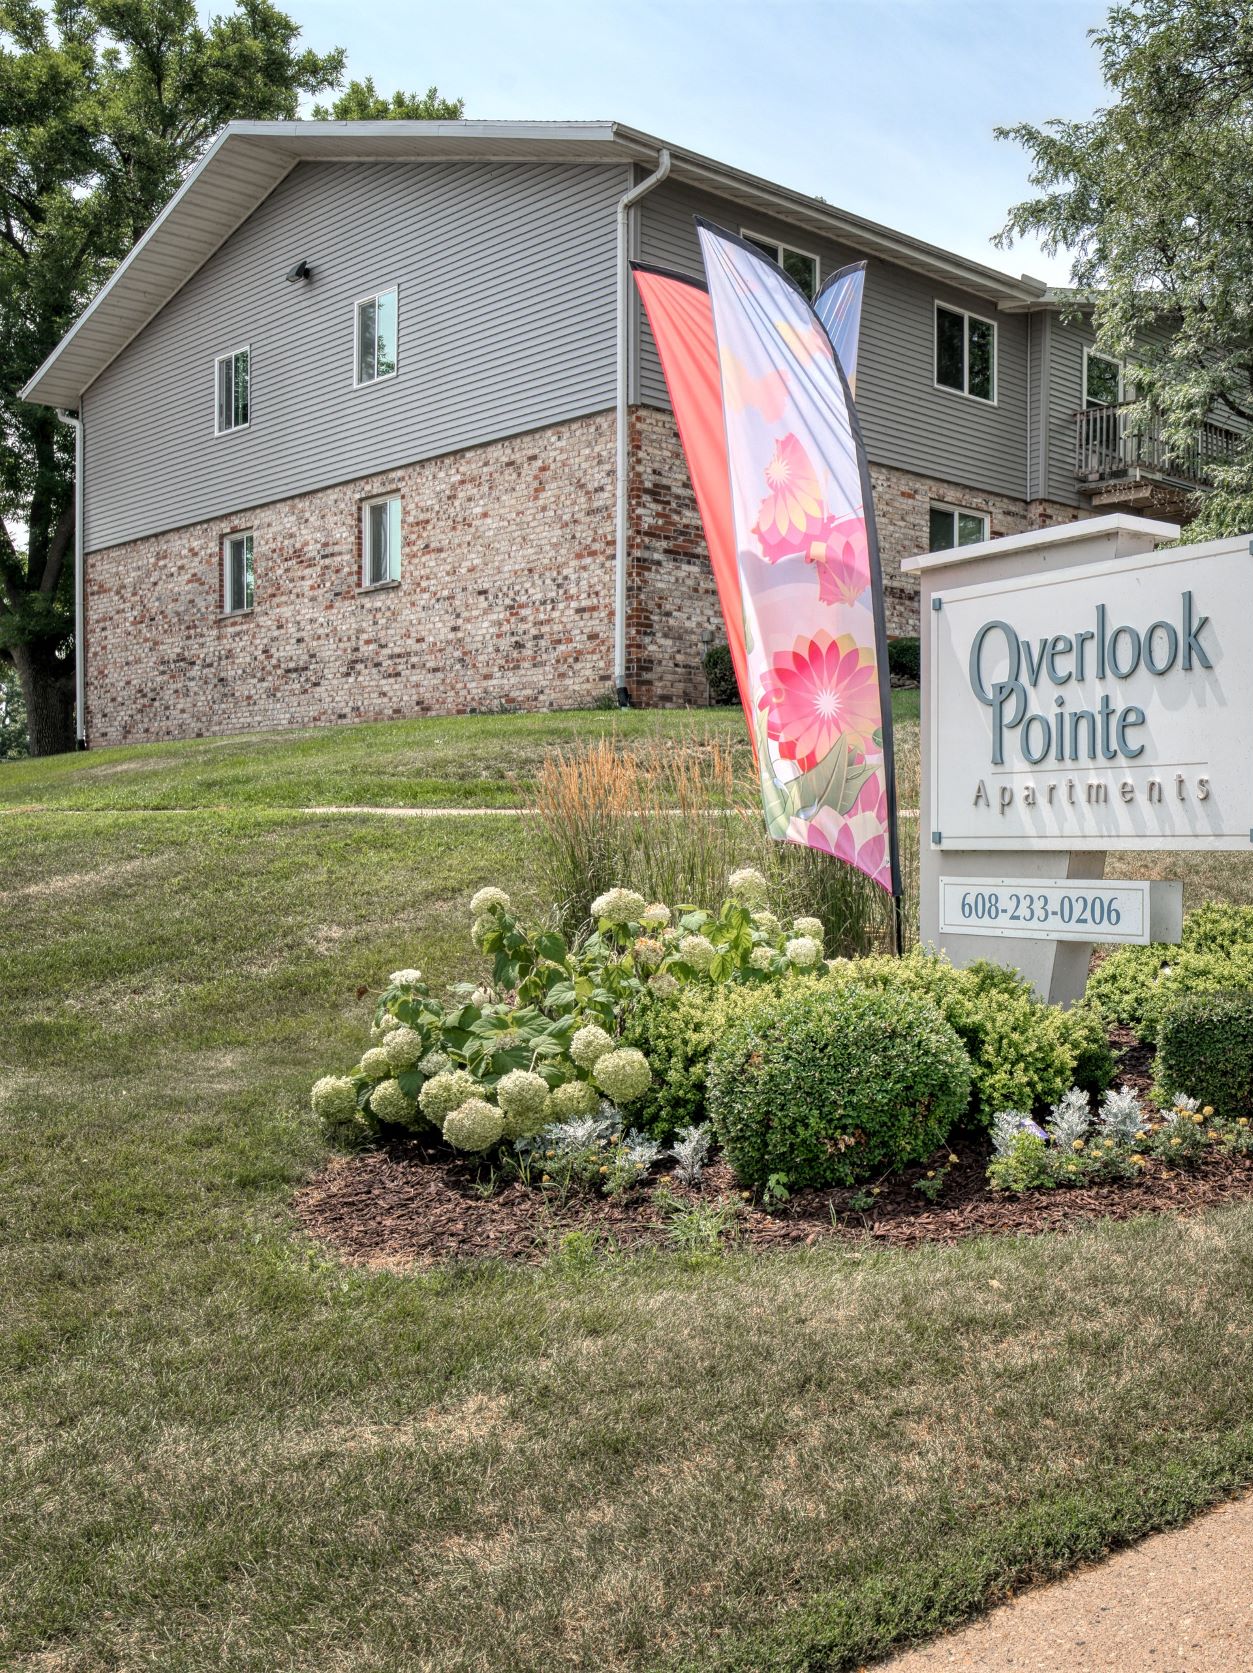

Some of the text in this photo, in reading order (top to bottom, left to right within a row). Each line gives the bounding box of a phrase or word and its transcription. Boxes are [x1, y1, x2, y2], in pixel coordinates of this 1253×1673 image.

[969, 590, 1213, 705] Overlook
[990, 680, 1145, 765] Pointe
[973, 773, 1211, 815] Apartments
[961, 892, 1121, 926] 608-233-0206
